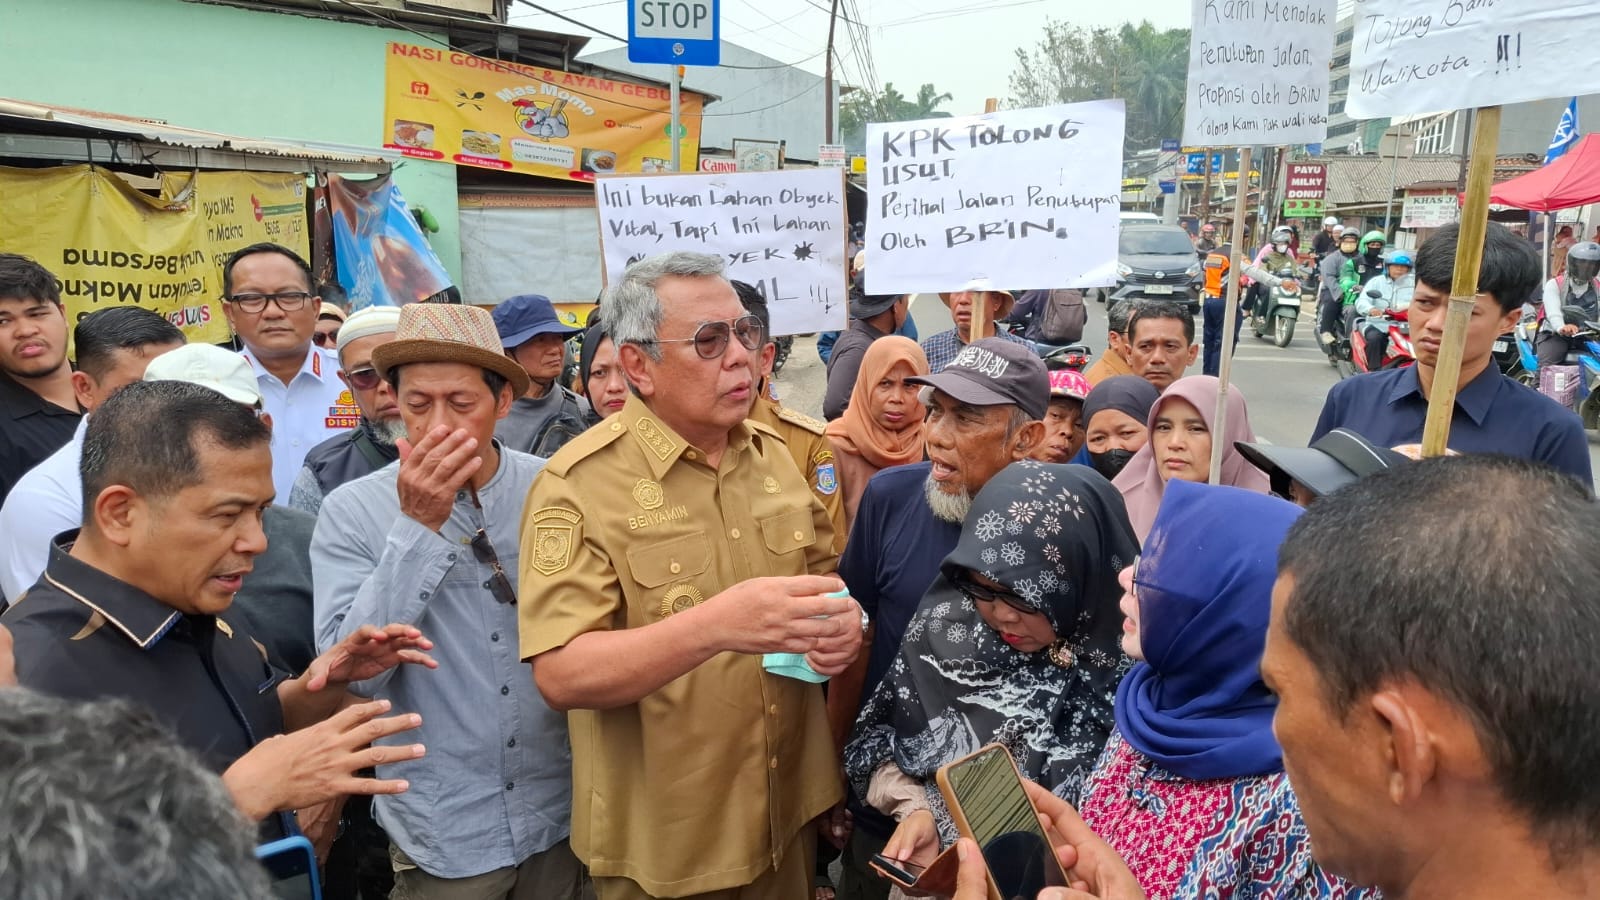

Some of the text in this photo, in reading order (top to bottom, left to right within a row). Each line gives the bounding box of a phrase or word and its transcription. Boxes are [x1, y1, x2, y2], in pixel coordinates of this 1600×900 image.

[641, 1, 707, 28] STOP
[1264, 1, 1326, 25] Menolak
[1364, 14, 1432, 54] Tolong
[392, 43, 442, 61] NASI
[450, 53, 536, 77] GORENG
[543, 70, 555, 82] &
[562, 74, 614, 92] AYAM
[496, 83, 595, 116] Mas Momo
[1288, 85, 1320, 104] BRIN
[882, 127, 955, 163] KPK
[966, 119, 1084, 149] TOLONG
[701, 159, 737, 172] Canon
[1294, 166, 1321, 174] PAYU
[1288, 190, 1323, 198] DONUT
[1291, 178, 1322, 186] MILKY
[220, 197, 235, 215] IM3
[602, 183, 632, 208] Ini
[642, 185, 702, 208] bukan
[709, 189, 772, 206] Lahan
[779, 188, 839, 208] Obyek
[953, 189, 1014, 210] Jalan
[1027, 185, 1120, 213] Penutupan
[216, 223, 243, 241] Makna
[670, 220, 718, 243] Tapi
[732, 216, 760, 234] Ini
[773, 215, 831, 232] Lahan
[881, 232, 927, 251] Oleh
[63, 249, 178, 275] Bersama
[629, 505, 688, 530] BENYAMIN
